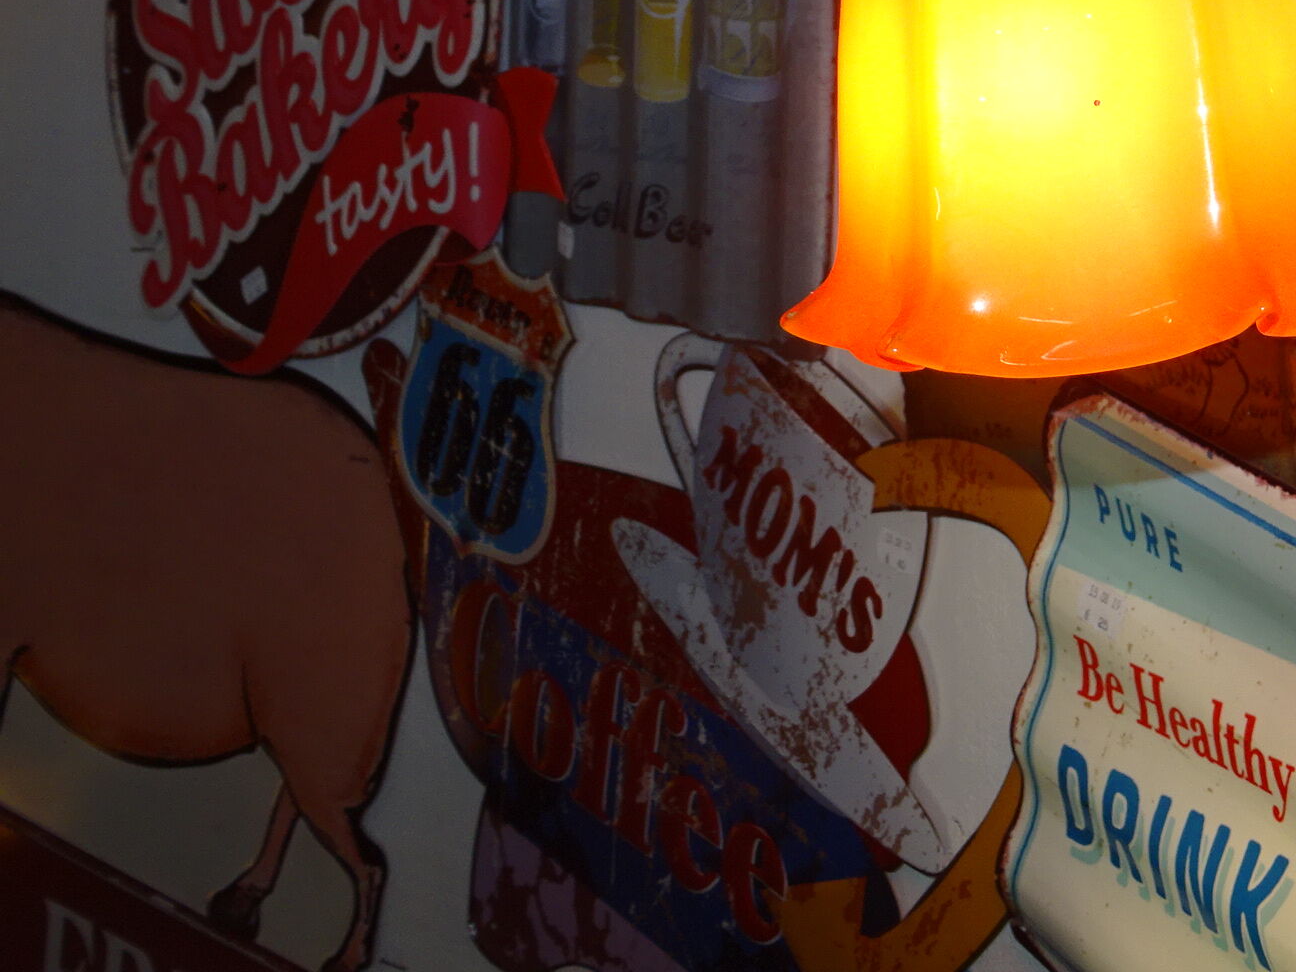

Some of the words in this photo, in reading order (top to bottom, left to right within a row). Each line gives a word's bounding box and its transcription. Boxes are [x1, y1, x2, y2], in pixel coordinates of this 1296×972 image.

[314, 121, 480, 256] tasty!
[417, 342, 535, 535] 66
[1094, 484, 1183, 573] PURE
[703, 424, 883, 654] MOM'S
[449, 578, 789, 945] Coffee
[1073, 634, 1125, 714] Be
[1130, 662, 1295, 823] Healthy
[1057, 744, 1290, 972] DRINK
